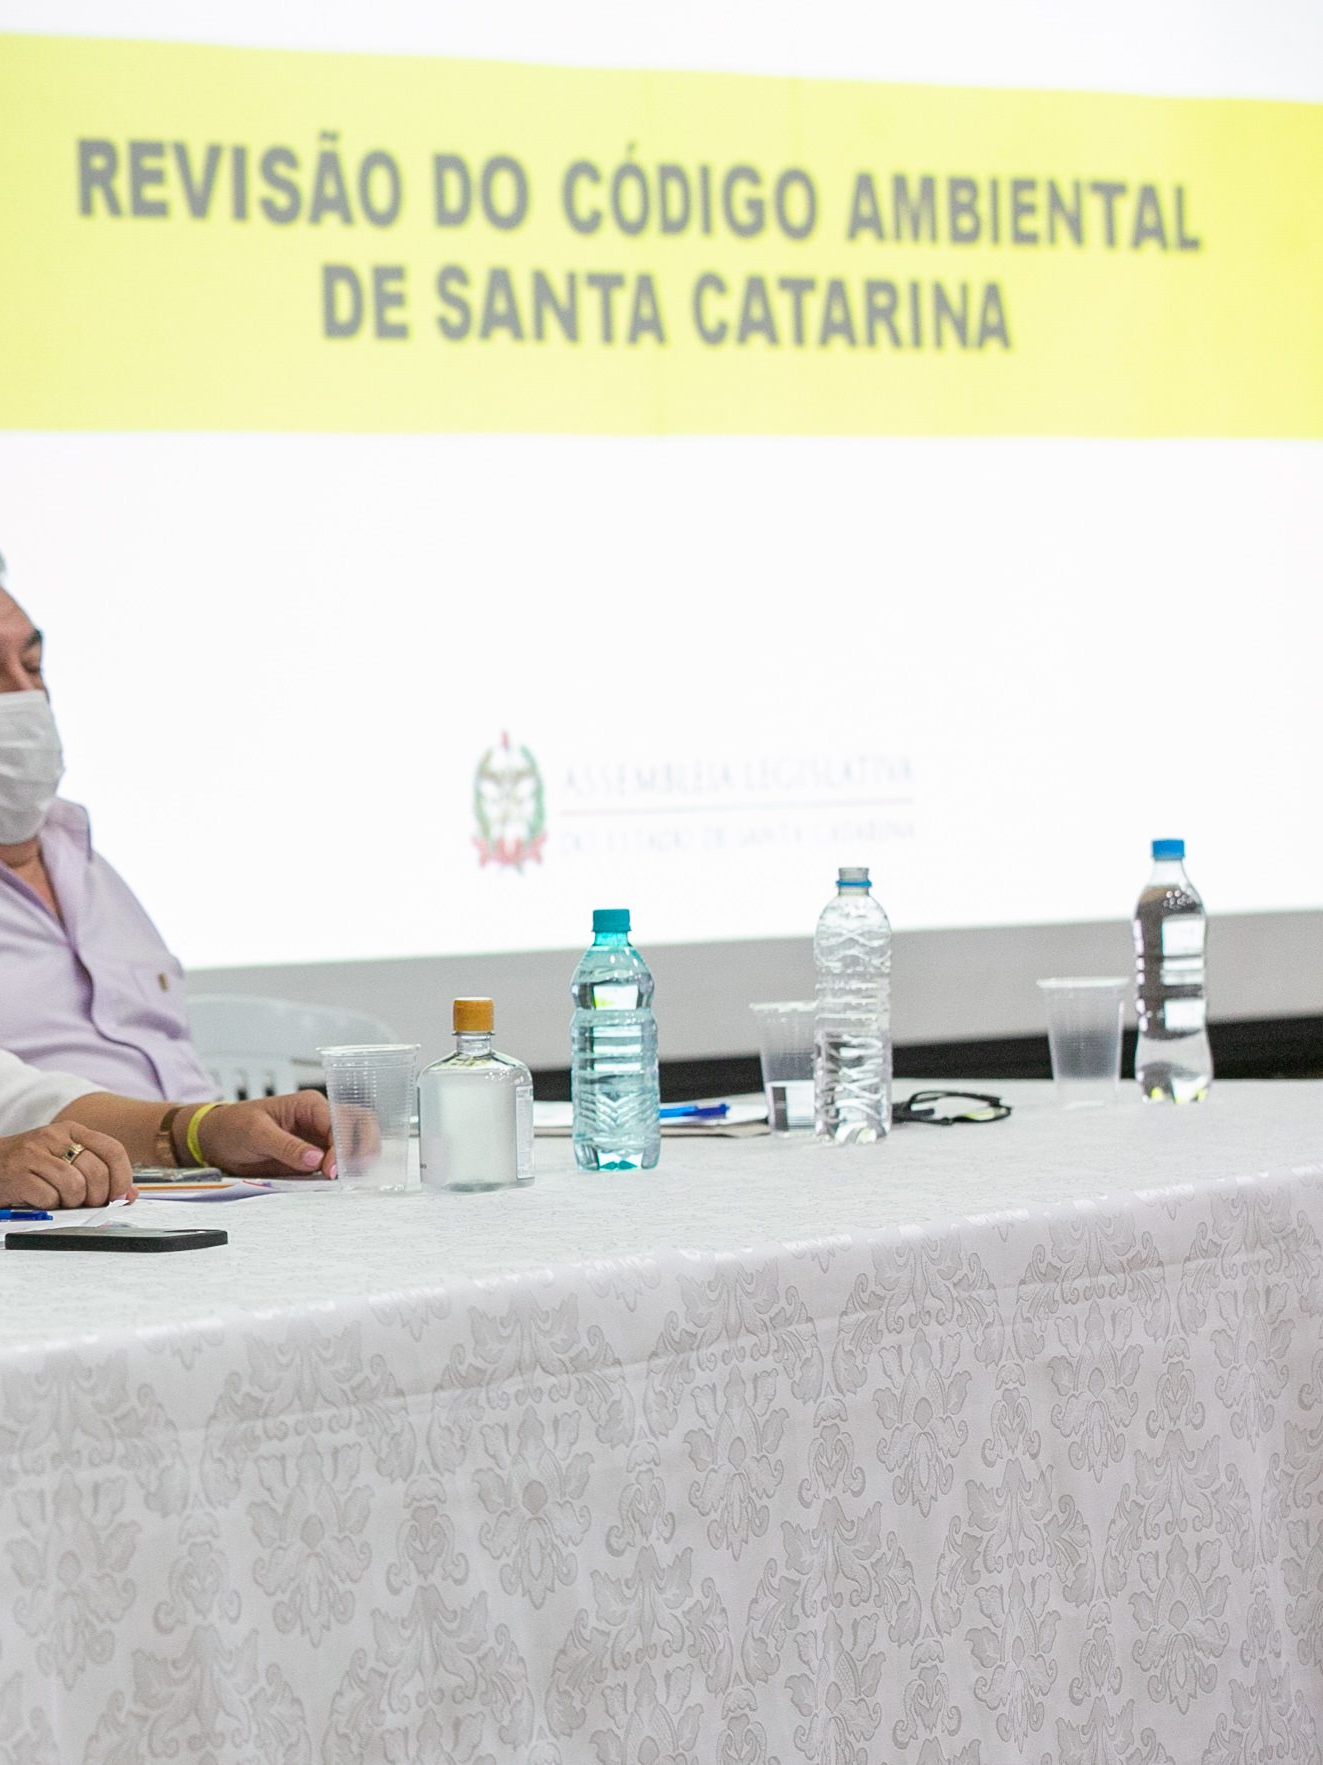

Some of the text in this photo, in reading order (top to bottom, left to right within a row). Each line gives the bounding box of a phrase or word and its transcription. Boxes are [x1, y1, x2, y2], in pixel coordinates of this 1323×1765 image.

[76, 129, 1203, 252] REVISÃO DO CÓDIGO AMBIENTAL
[321, 263, 1012, 350] DE SANTA CATARINA
